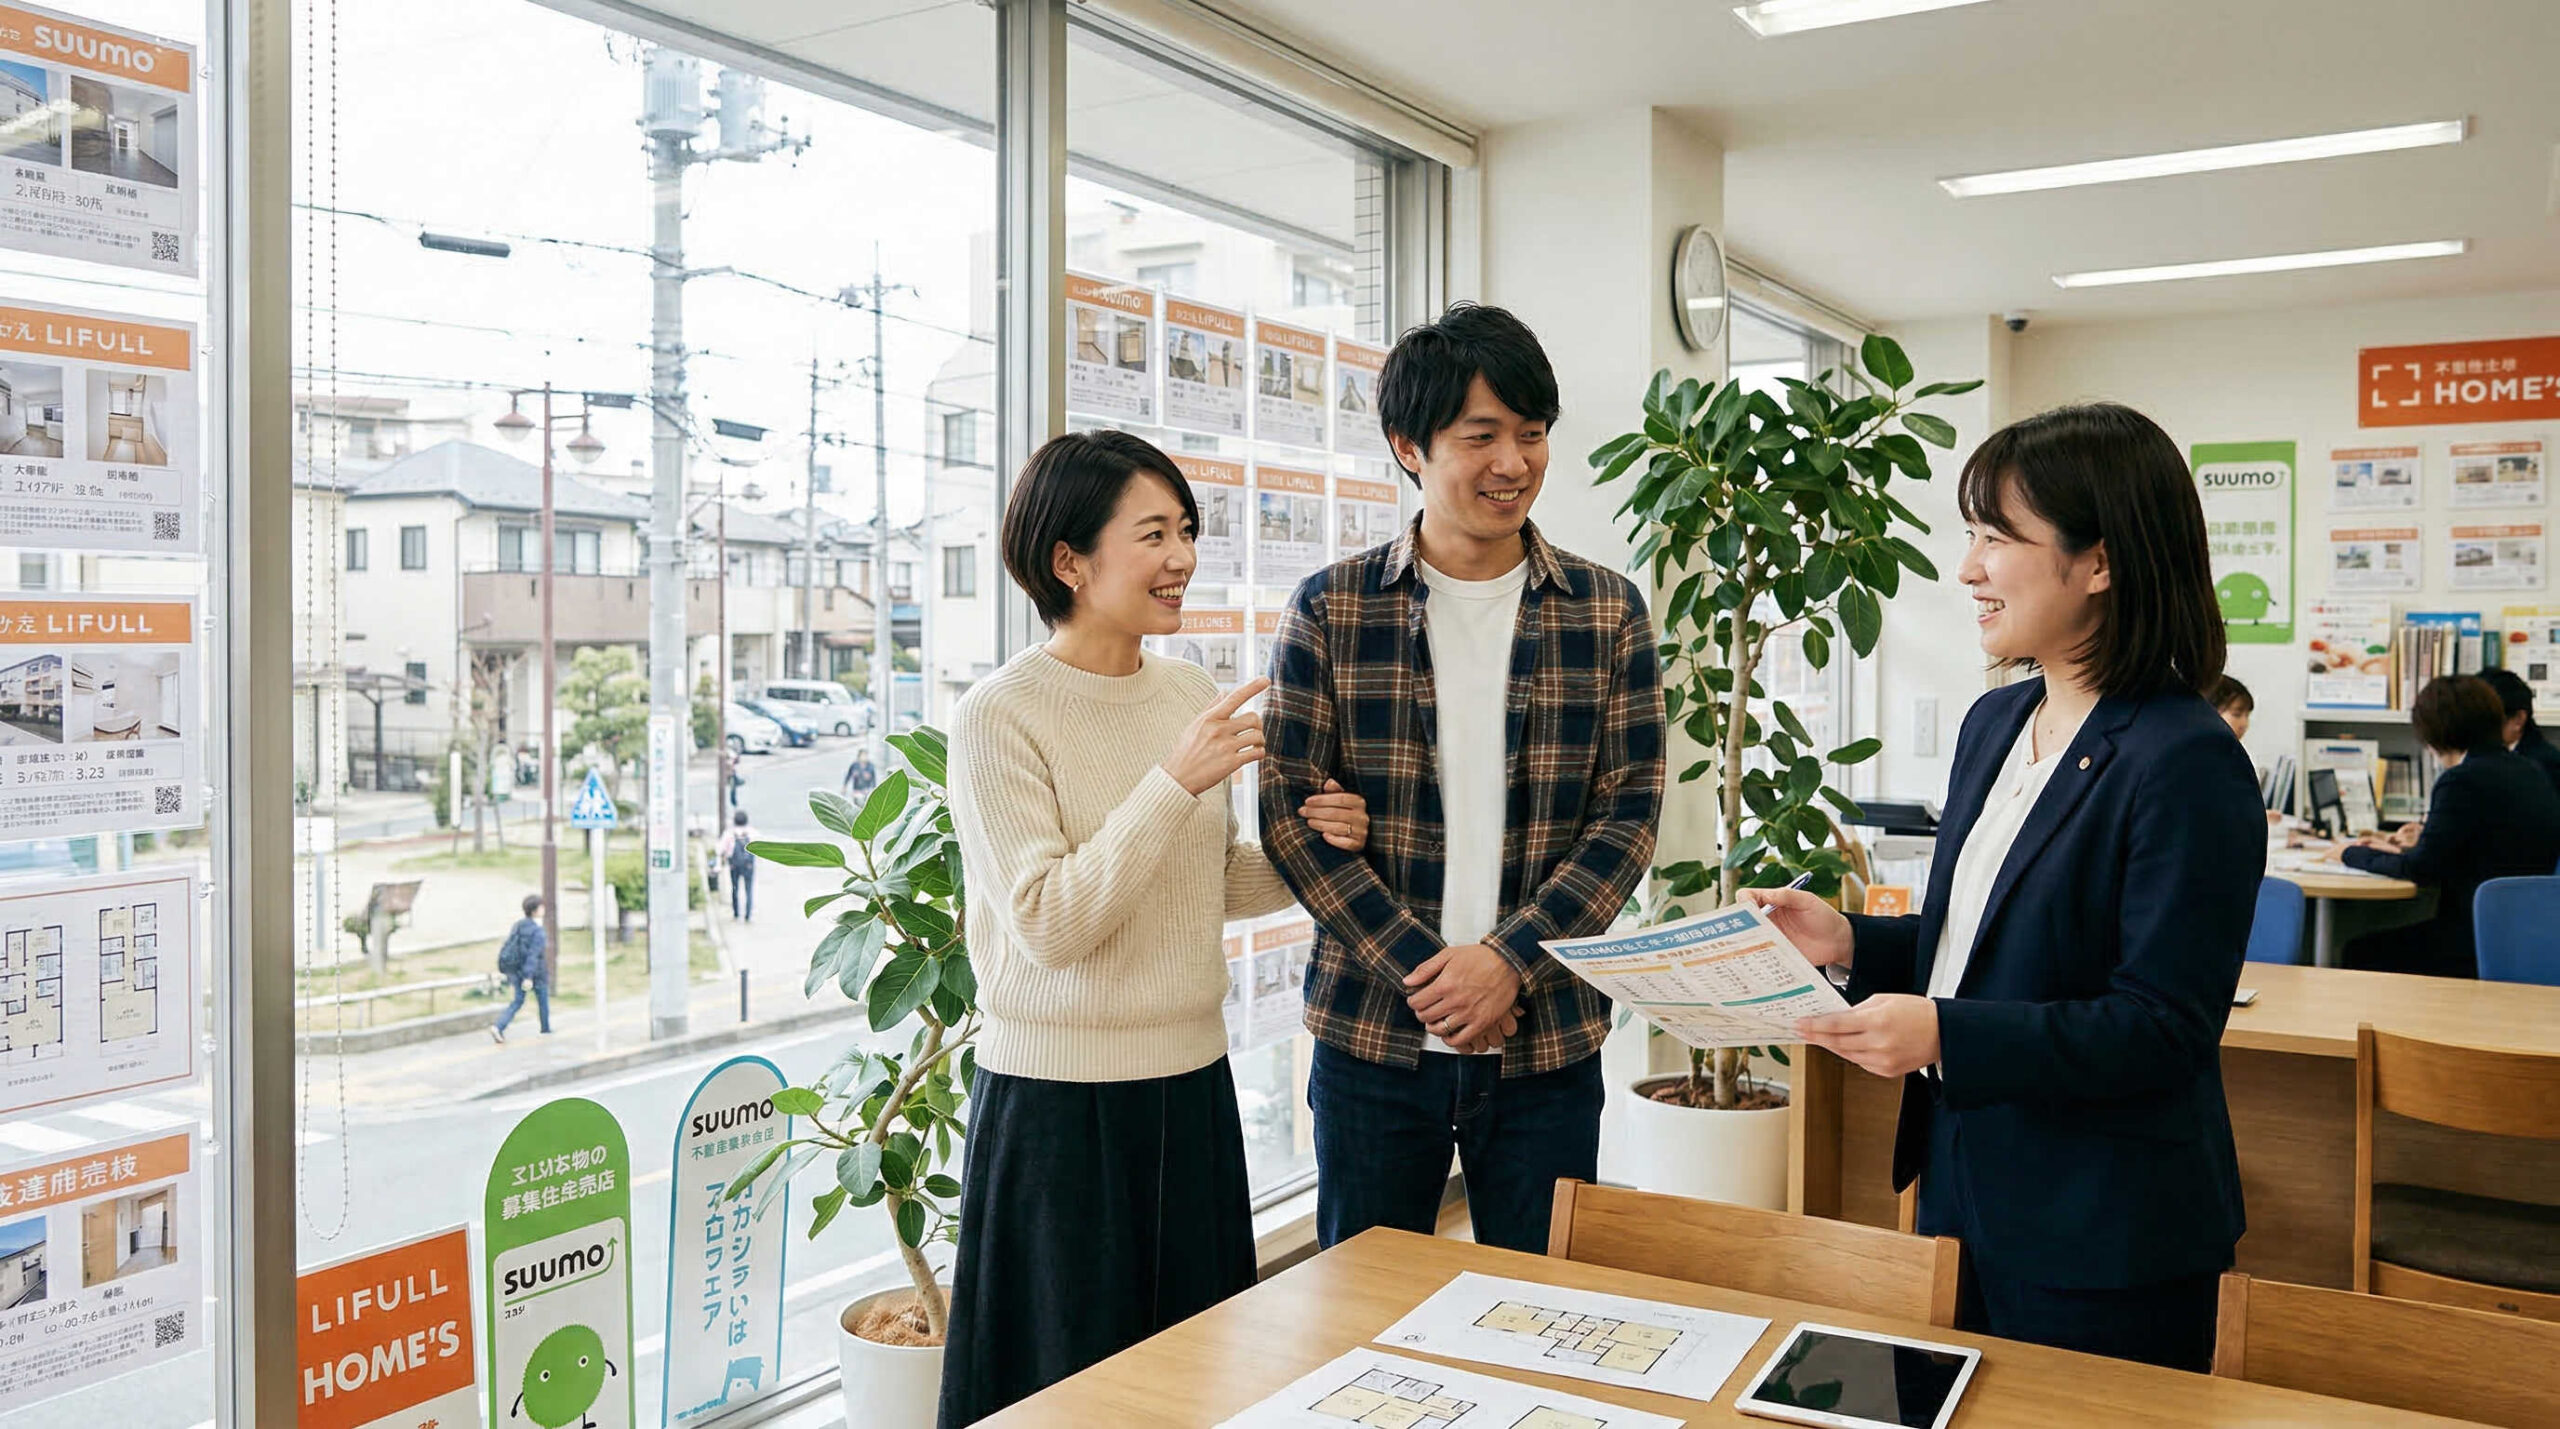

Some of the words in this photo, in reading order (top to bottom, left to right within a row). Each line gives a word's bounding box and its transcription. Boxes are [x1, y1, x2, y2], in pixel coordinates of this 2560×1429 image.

[34, 25, 155, 73] SUUMO
[46, 325, 153, 355] LIFULL
[2434, 376, 2560, 405] HOME'
[2204, 471, 2276, 487] SUUMO
[47, 614, 153, 634] LIFULL
[692, 1098, 774, 1138] SUUMO
[504, 1244, 605, 1296] SUUMO
[312, 1269, 448, 1333] LIFULL
[304, 1321, 460, 1406] HOME'S
